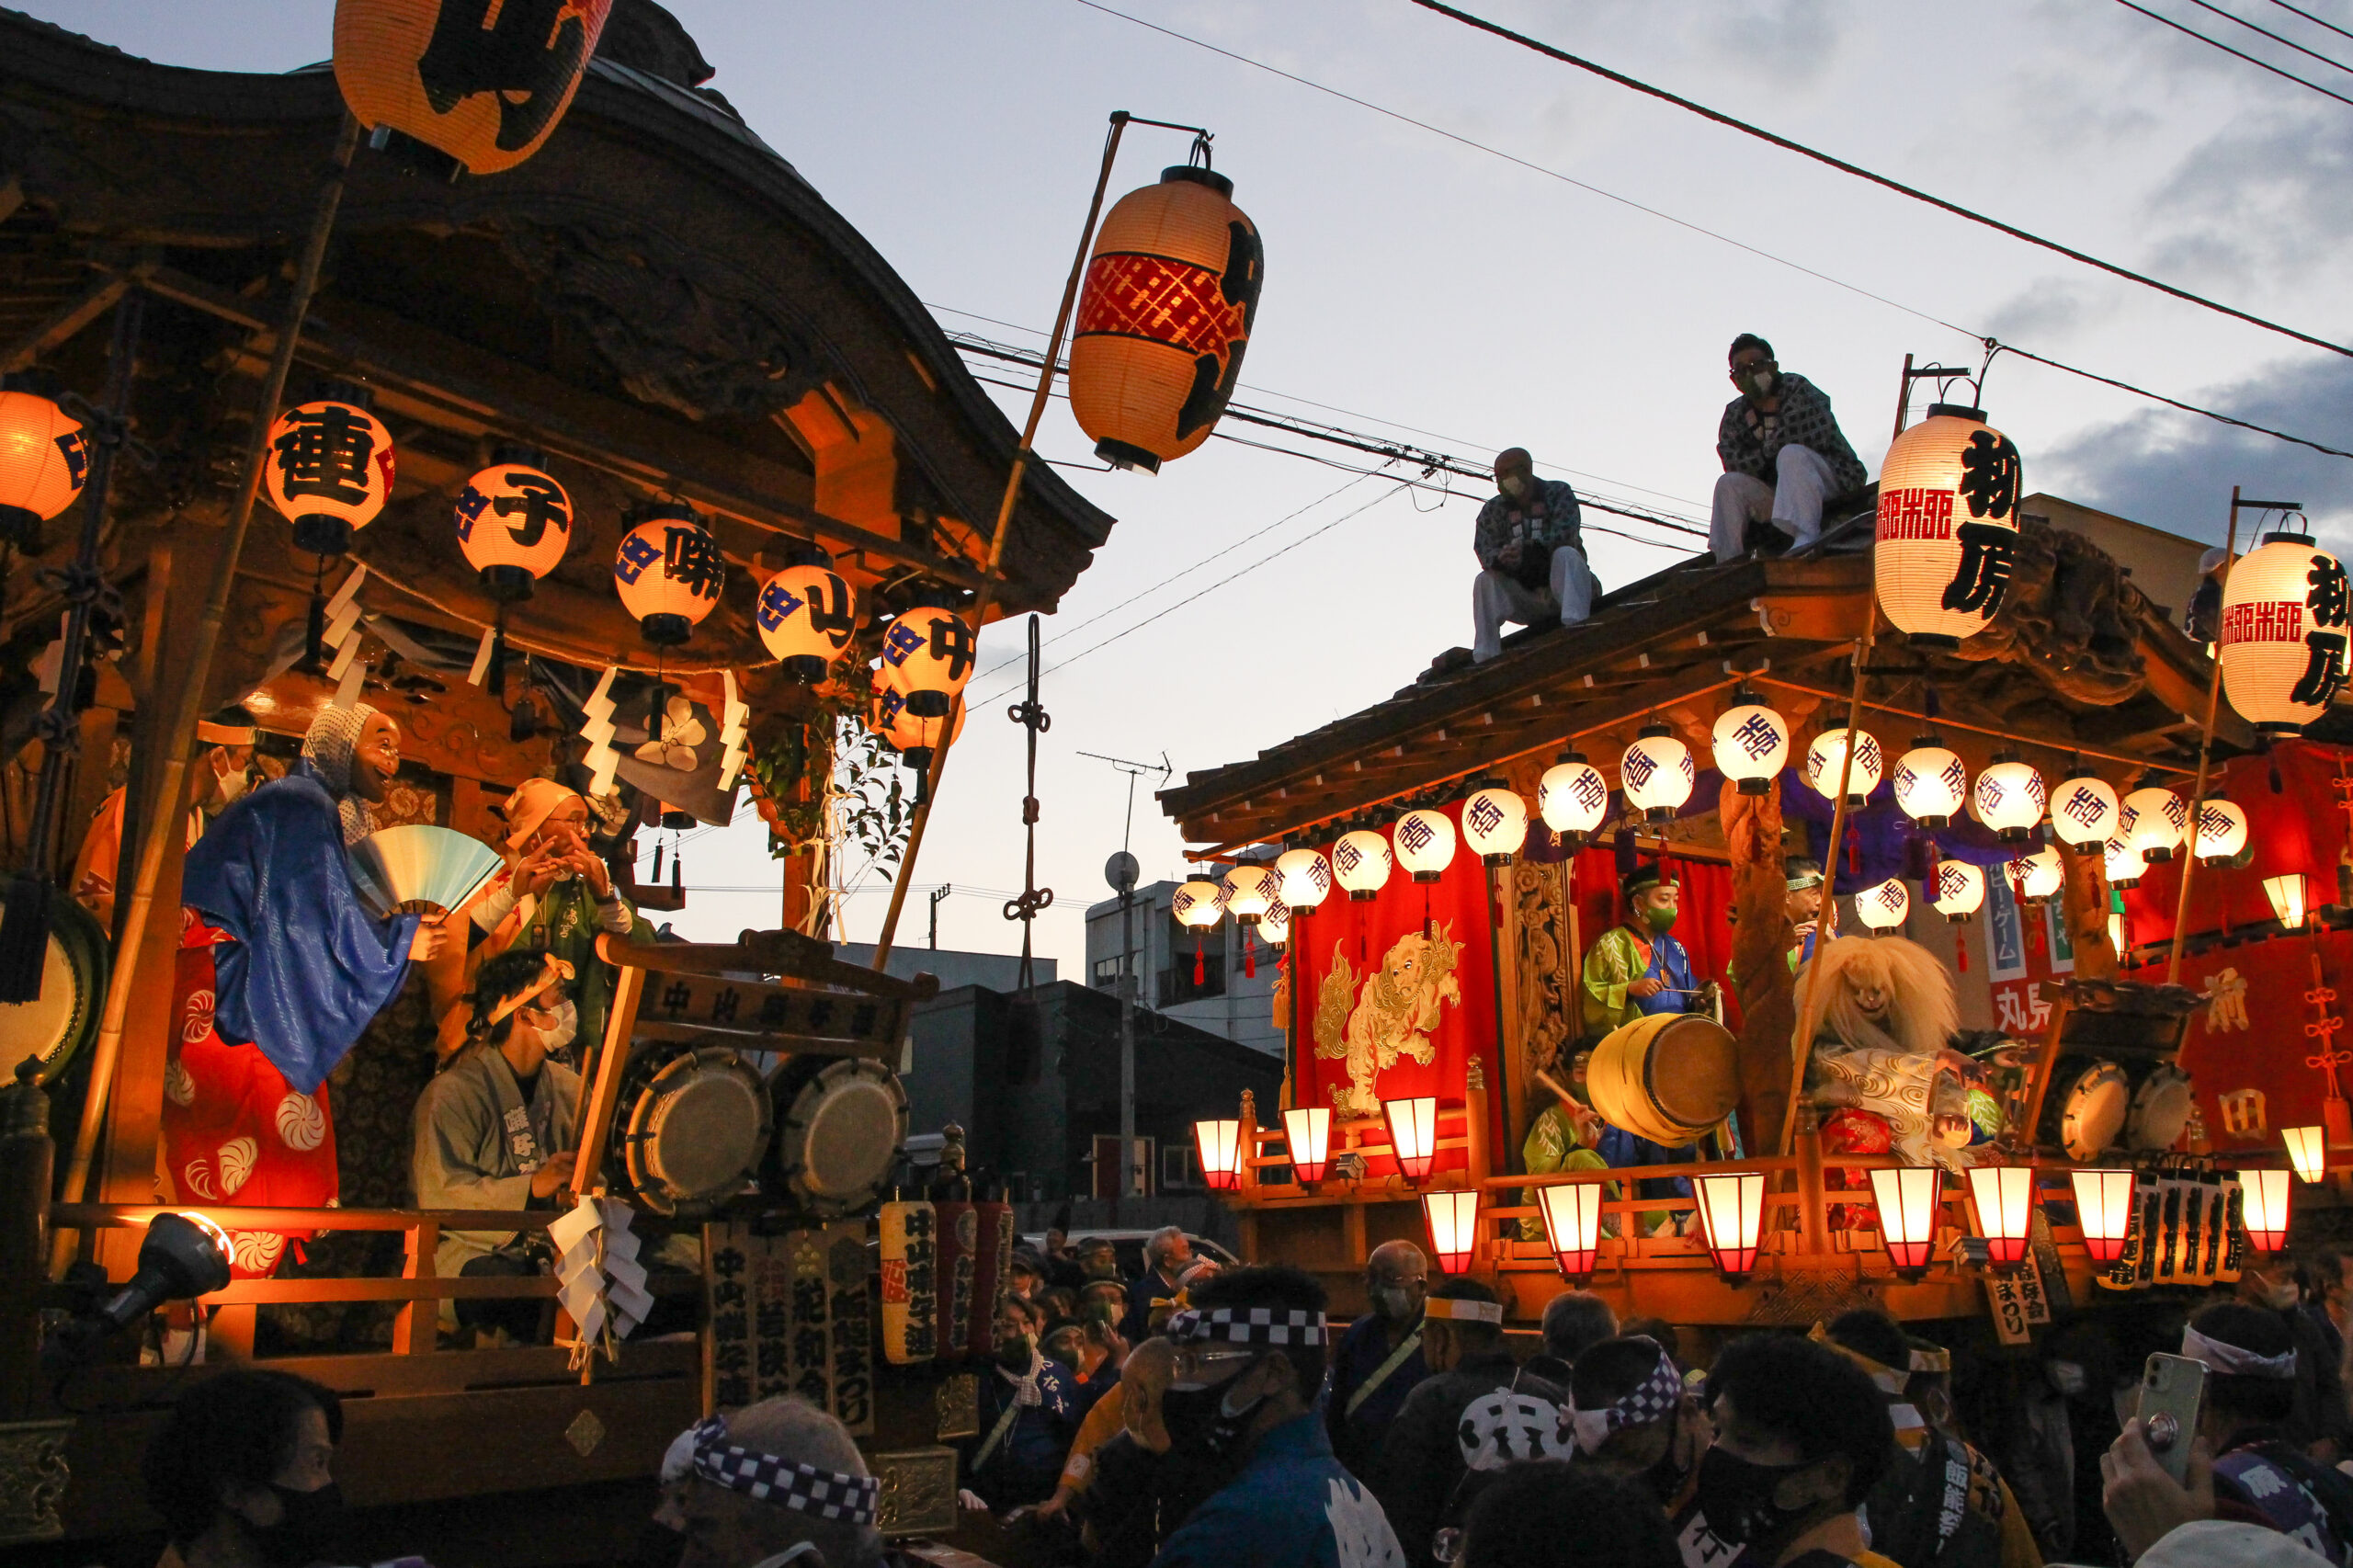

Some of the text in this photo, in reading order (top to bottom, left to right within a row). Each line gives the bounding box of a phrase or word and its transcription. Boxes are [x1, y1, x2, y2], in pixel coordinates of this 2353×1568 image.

[273, 406, 375, 506] 連
[493, 472, 568, 547] 子
[804, 574, 858, 649] 山
[927, 615, 975, 681] 中
